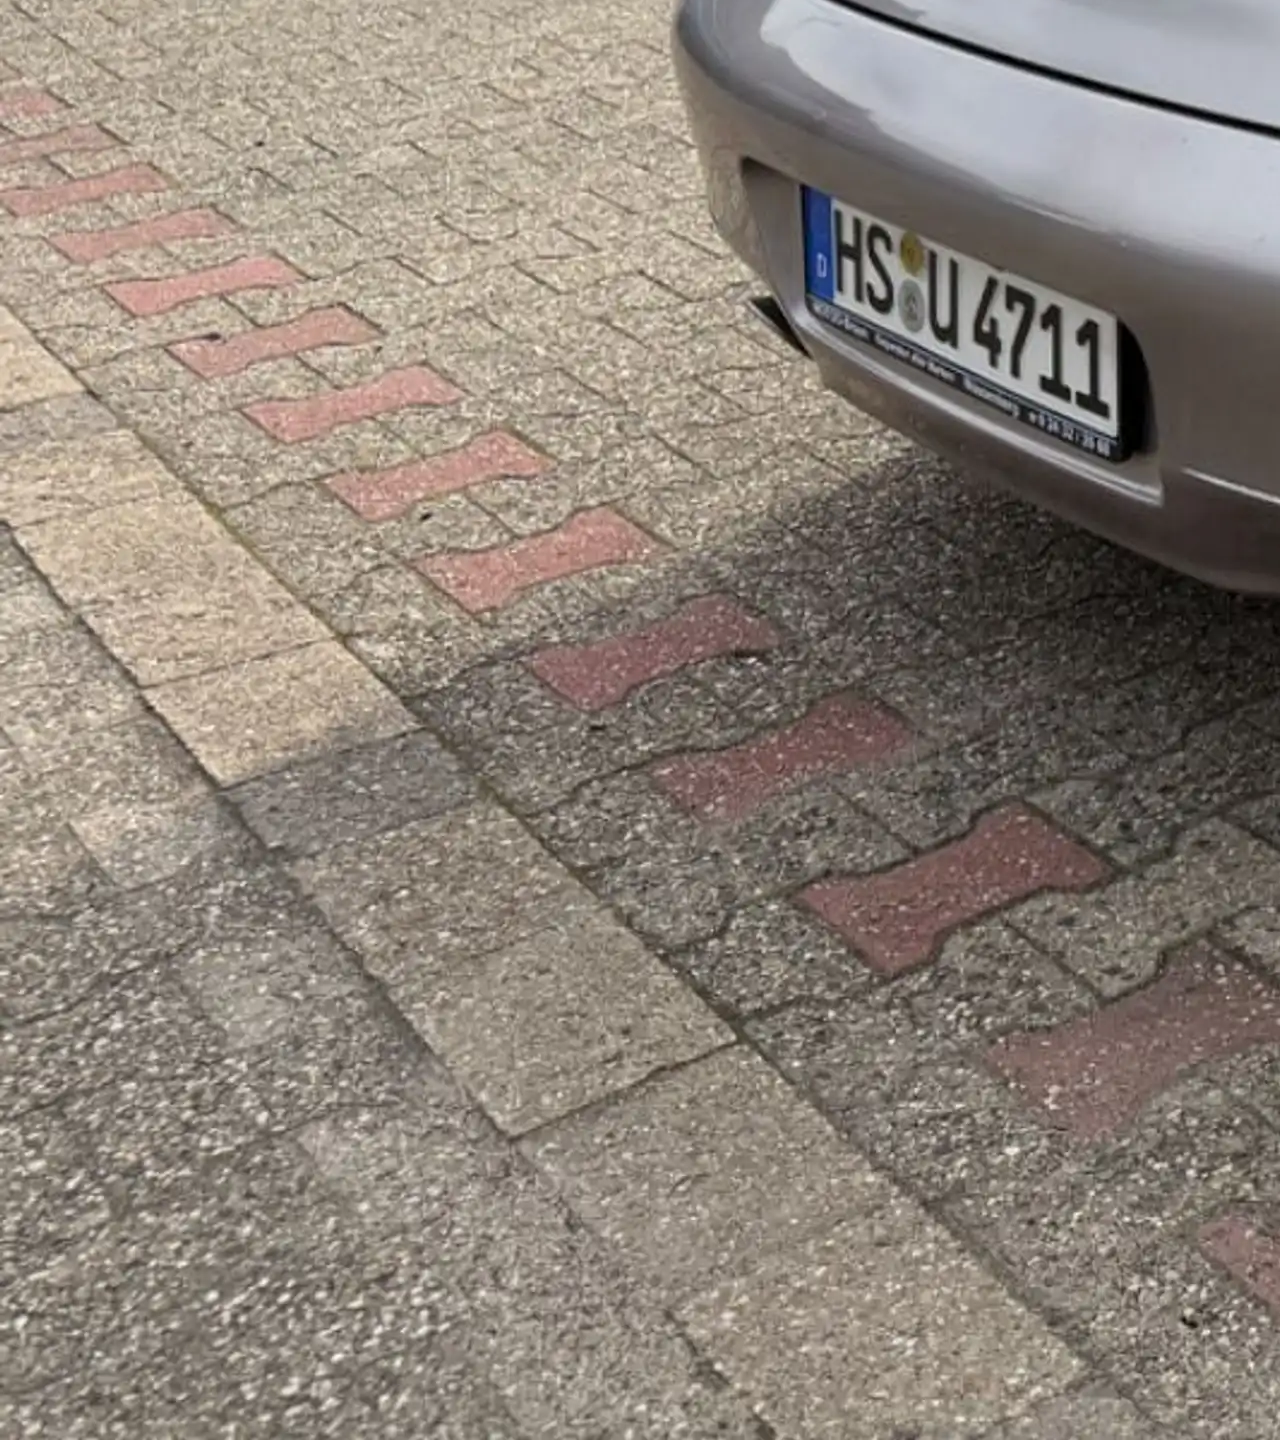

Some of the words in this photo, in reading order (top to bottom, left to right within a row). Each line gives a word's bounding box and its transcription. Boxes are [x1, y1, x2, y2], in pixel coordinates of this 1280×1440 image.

[834, 207, 894, 316] HS
[928, 249, 959, 350] U
[972, 274, 1110, 420] 4711
